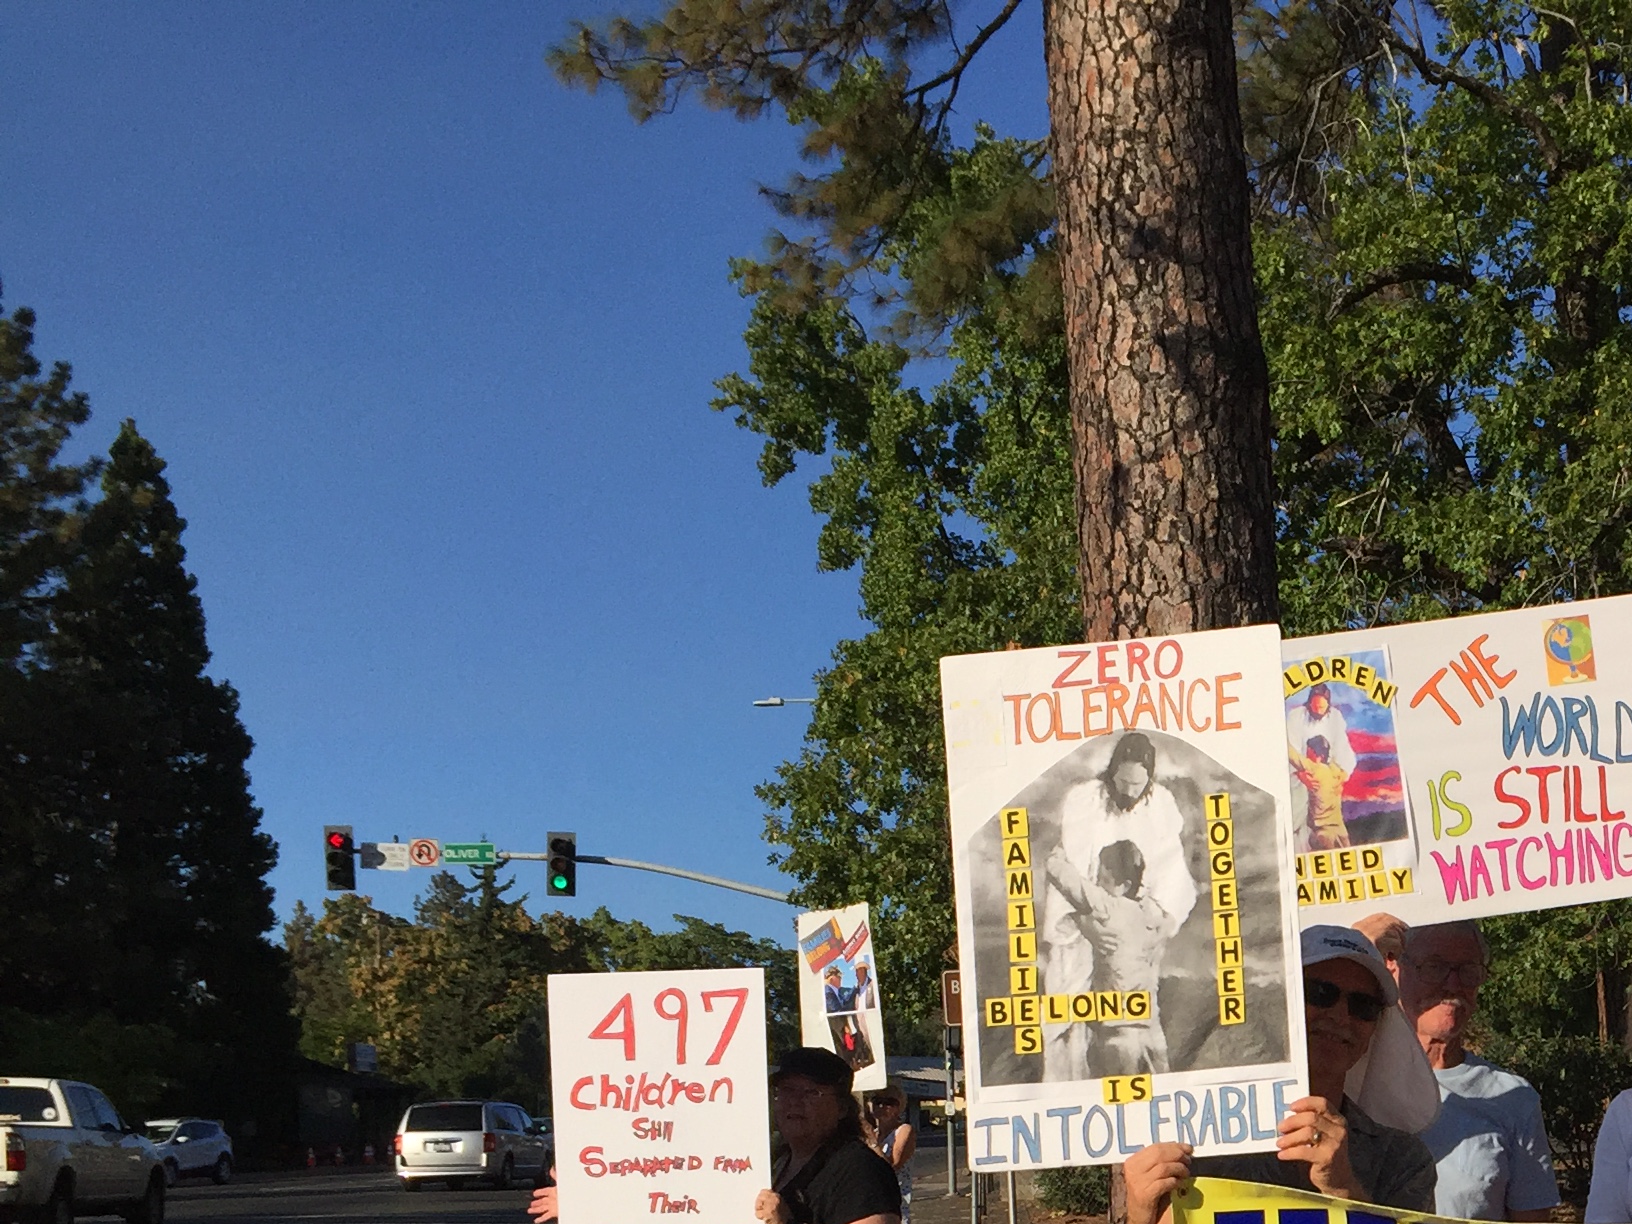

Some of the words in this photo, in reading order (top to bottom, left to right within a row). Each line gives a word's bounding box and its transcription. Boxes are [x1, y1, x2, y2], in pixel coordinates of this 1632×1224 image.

[1052, 640, 1184, 688] ZERO
[1285, 659, 1392, 704] LDREN
[1410, 634, 1517, 725] THE
[1004, 672, 1243, 745] TOLERANCE
[1427, 770, 1472, 840] IS
[1494, 765, 1625, 829] STILL
[445, 849, 479, 858] OLIVER
[1209, 794, 1243, 1020] TOGETHER
[1297, 870, 1408, 901] AMILY
[1006, 811, 1037, 1052] FAMILIES
[588, 988, 748, 1065] 497
[990, 992, 1147, 1025] BELONG
[570, 1072, 733, 1112] Children
[1108, 1078, 1146, 1101] IS
